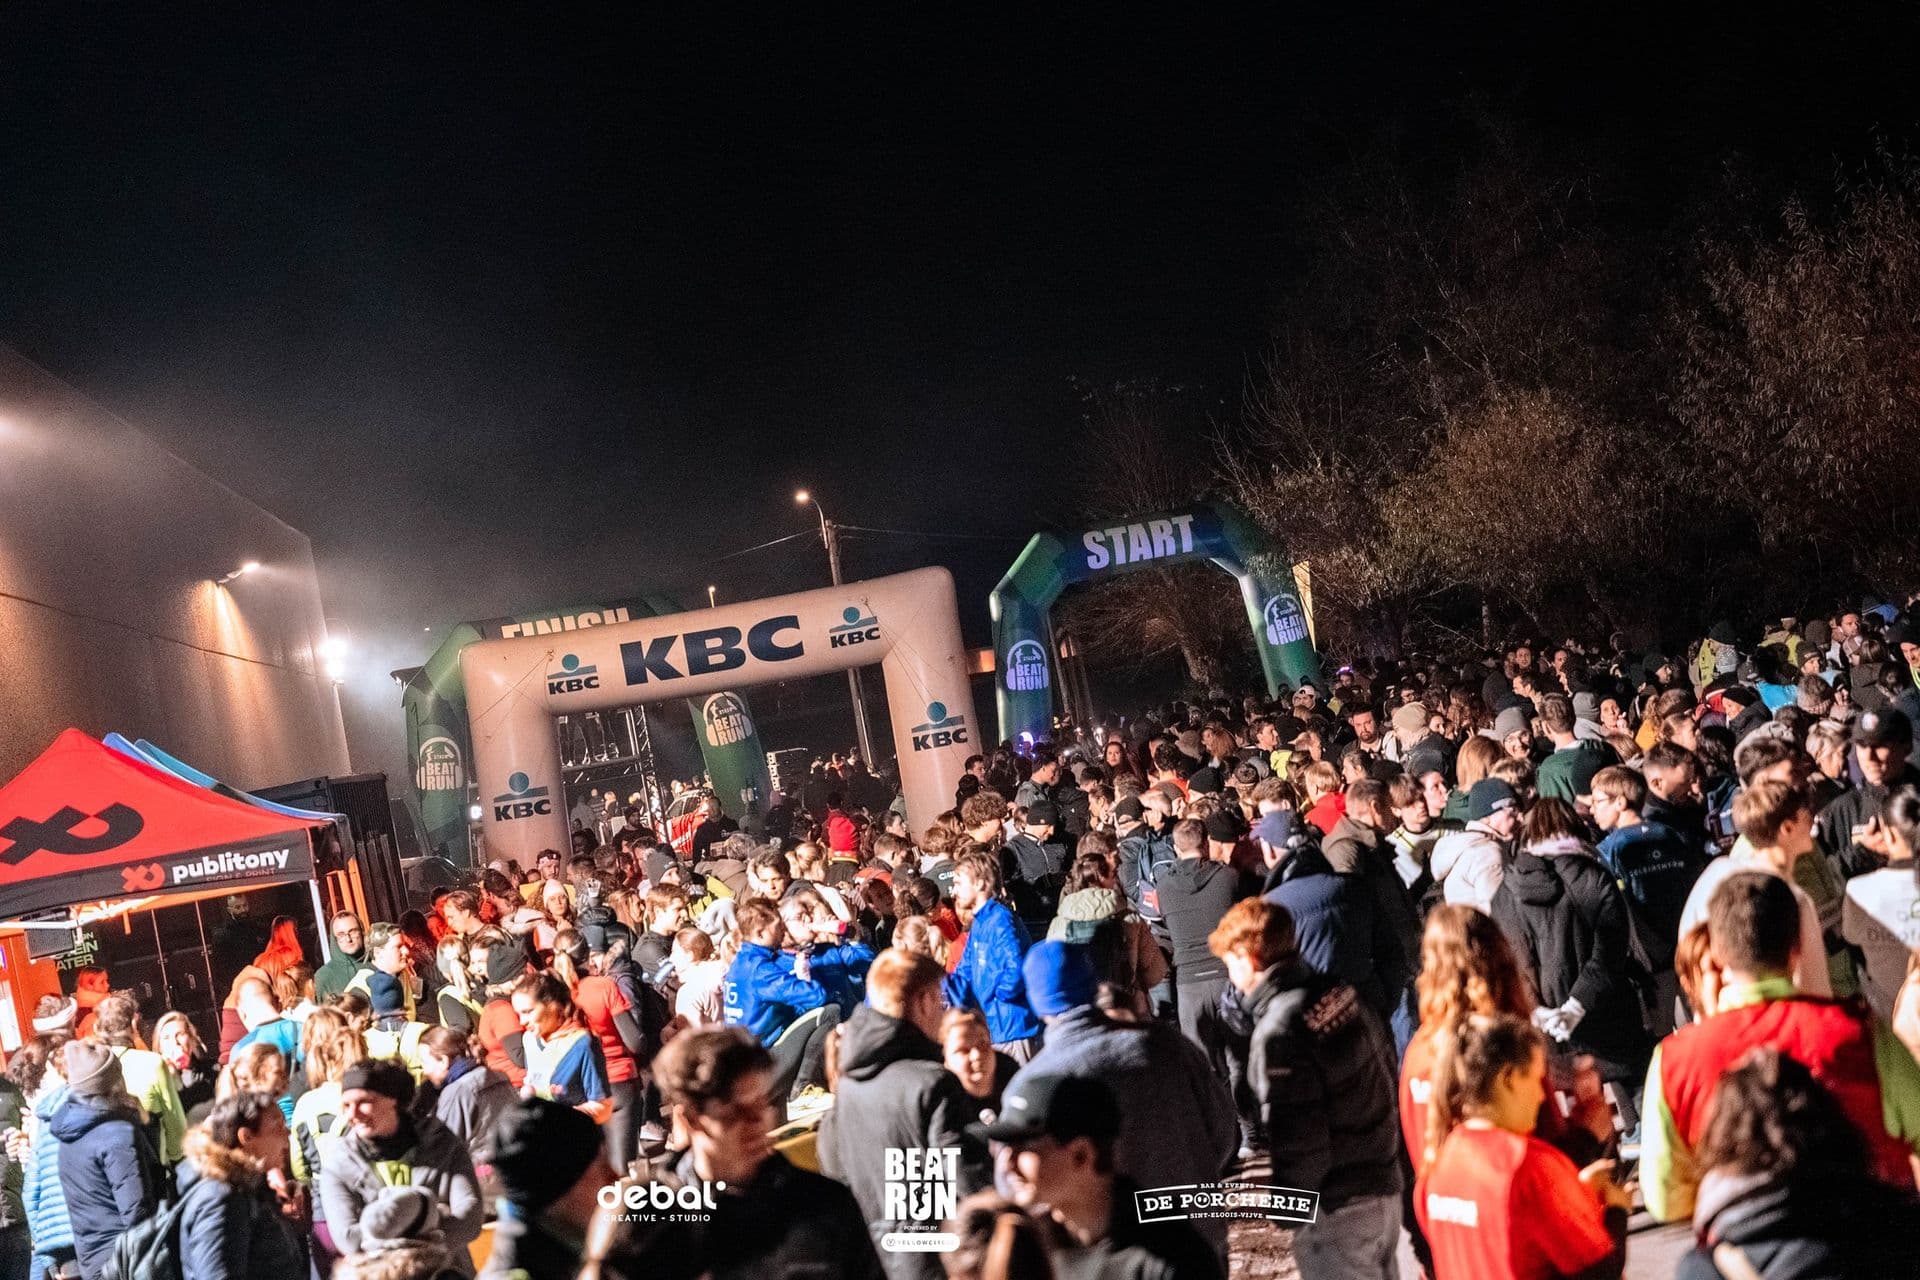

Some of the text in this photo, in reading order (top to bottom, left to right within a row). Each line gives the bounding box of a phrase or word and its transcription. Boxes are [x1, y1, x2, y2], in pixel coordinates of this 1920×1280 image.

[1083, 514, 1194, 570] START
[1274, 614, 1301, 632] BEAT
[830, 627, 881, 649] KBC
[1278, 626, 1304, 645] RUN
[620, 615, 805, 687] KBC
[1016, 663, 1043, 676] BEAT
[547, 675, 600, 695] KBC
[1017, 676, 1043, 691] RUN
[713, 713, 742, 732] BEAT
[717, 726, 747, 746] RUN
[912, 728, 969, 752] KBC
[426, 761, 455, 775] BEAT
[426, 775, 455, 790] RUN
[494, 799, 552, 822] KBC
[172, 848, 290, 884] publitony
